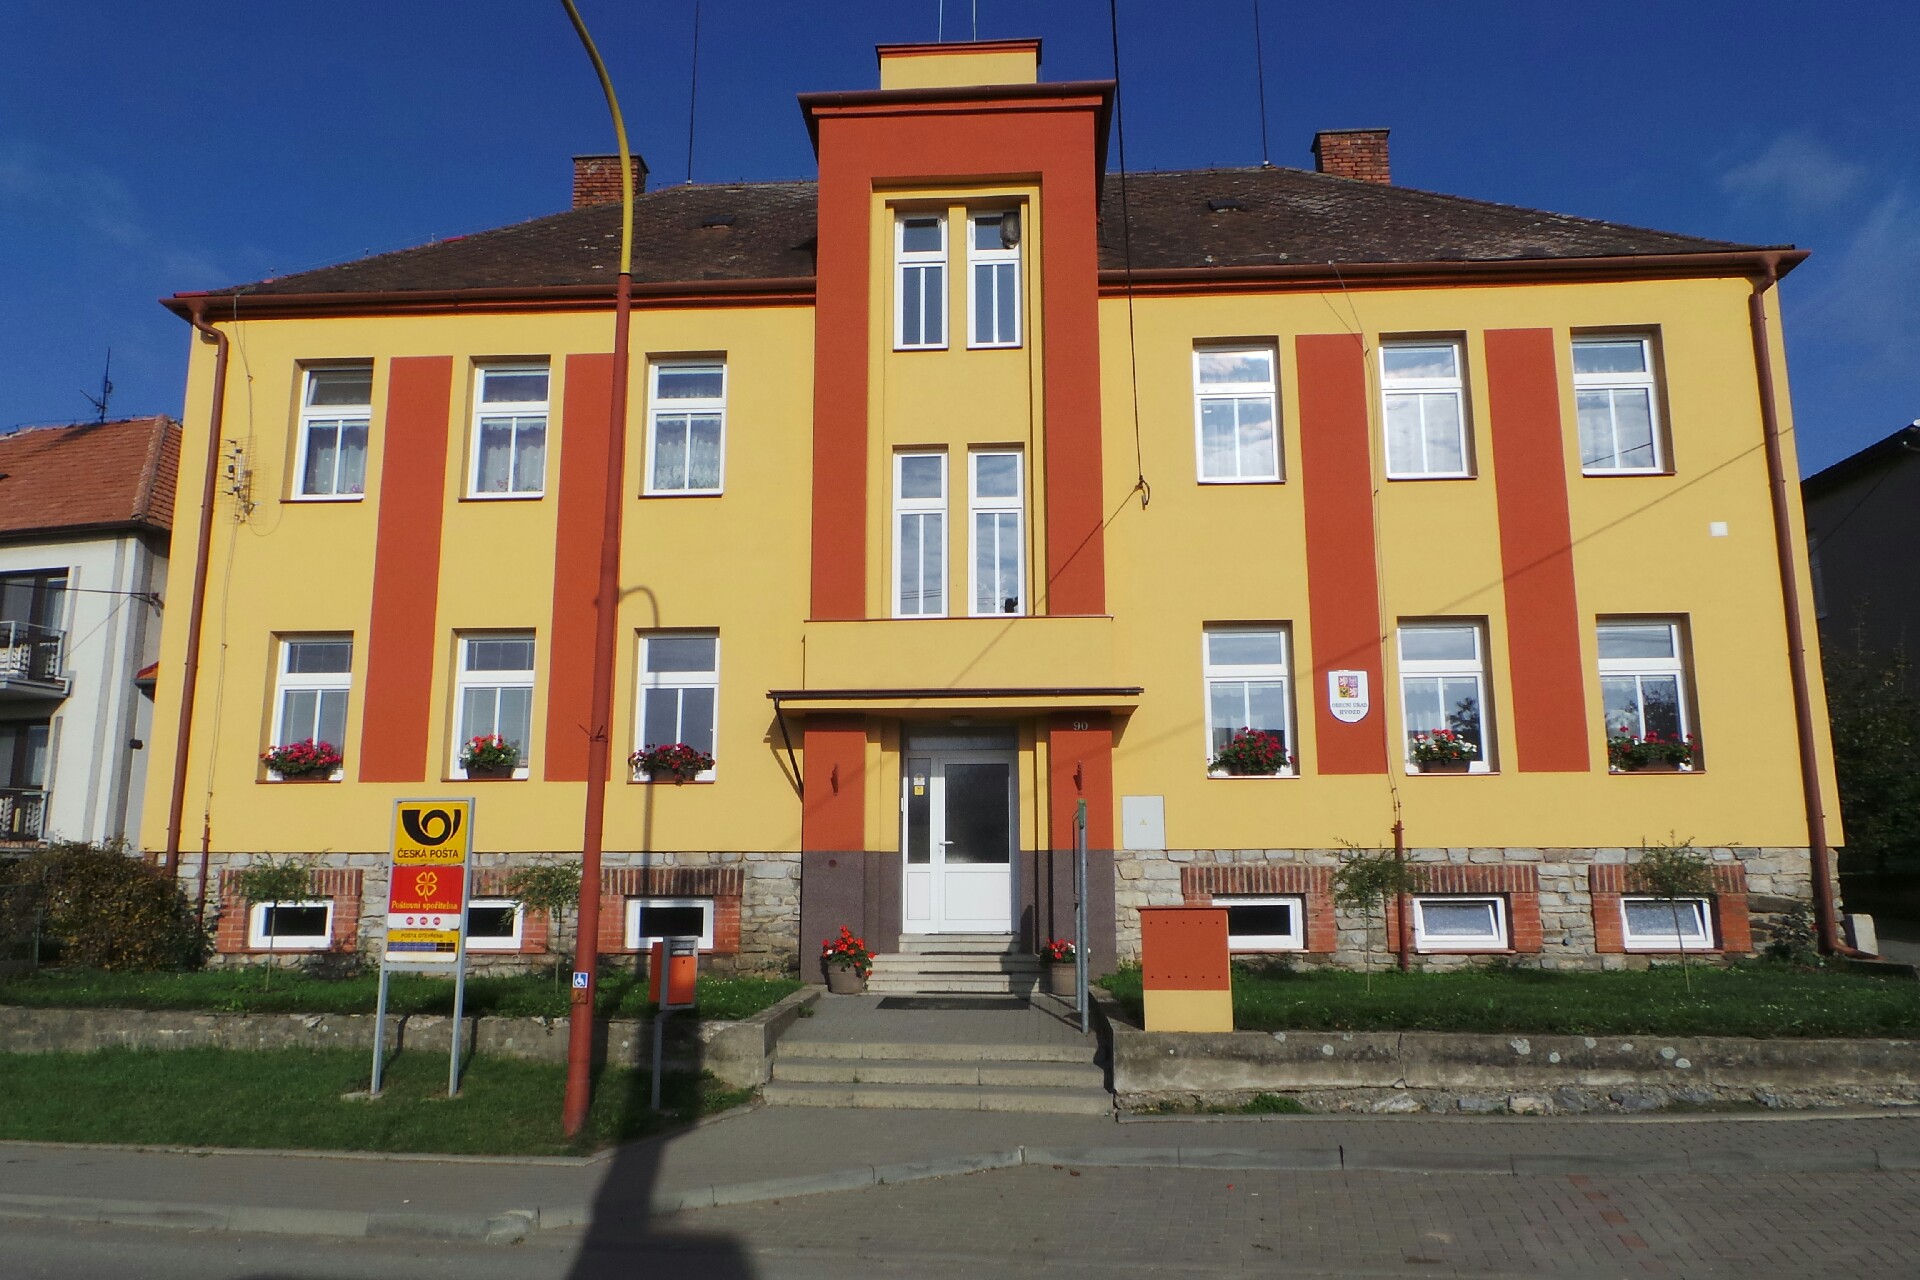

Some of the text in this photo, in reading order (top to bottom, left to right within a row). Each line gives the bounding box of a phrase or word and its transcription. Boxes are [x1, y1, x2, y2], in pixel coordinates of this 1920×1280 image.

[1073, 721, 1088, 731] 90
[397, 847, 459, 858] ČESKÁ POŠTA
[391, 900, 458, 911] Poštovní spořitelna
